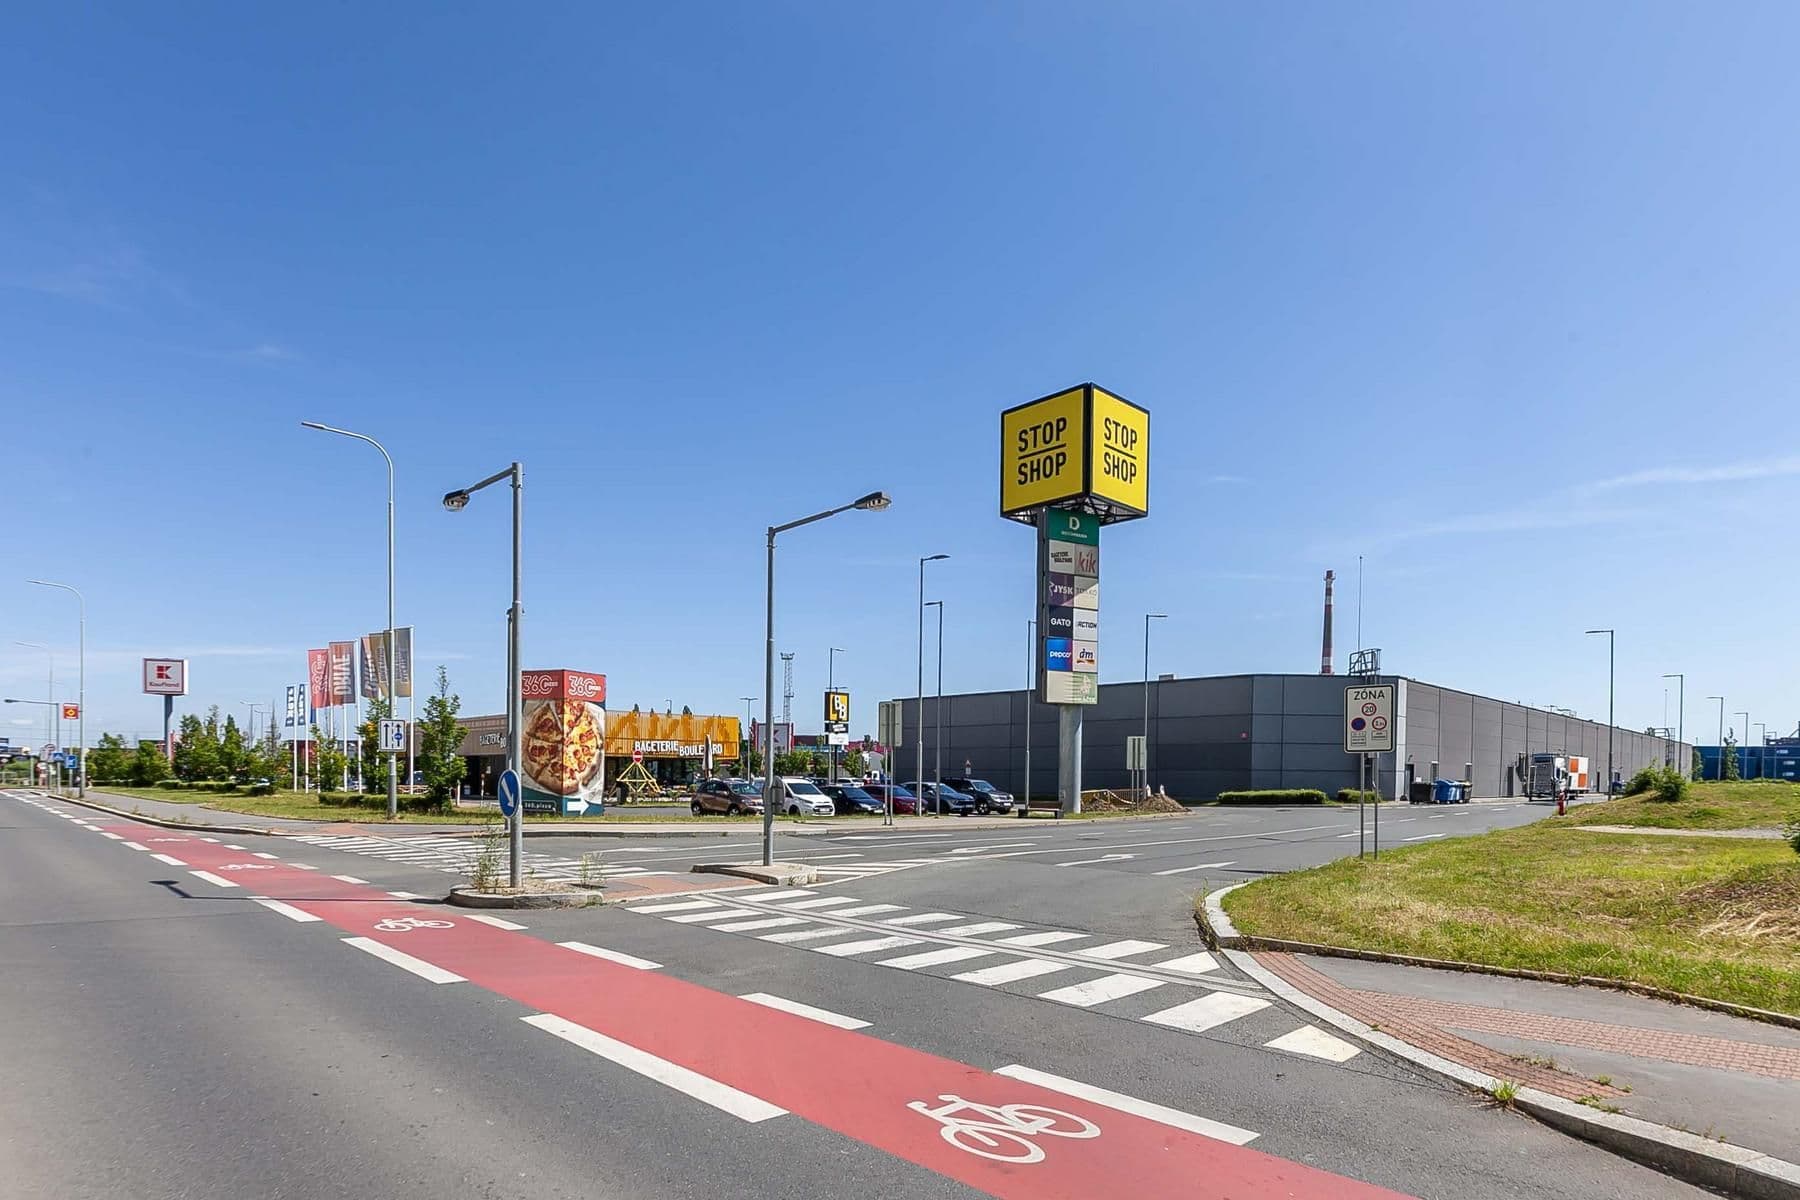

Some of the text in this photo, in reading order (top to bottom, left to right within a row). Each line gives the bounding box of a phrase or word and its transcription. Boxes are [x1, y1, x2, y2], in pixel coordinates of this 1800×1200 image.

[1018, 417, 1067, 452] STOP
[1104, 417, 1137, 451] STOP
[1018, 452, 1067, 485] SHOP
[1104, 452, 1137, 484] SHOP
[1069, 517, 1080, 530] D
[1053, 585, 1073, 595] JYSK
[1050, 617, 1071, 627] GATO
[1079, 648, 1094, 659] dm
[1353, 688, 1385, 700] ZÓNA
[1365, 705, 1374, 713] 20
[634, 741, 722, 756] BAGETERIE BOULERD
